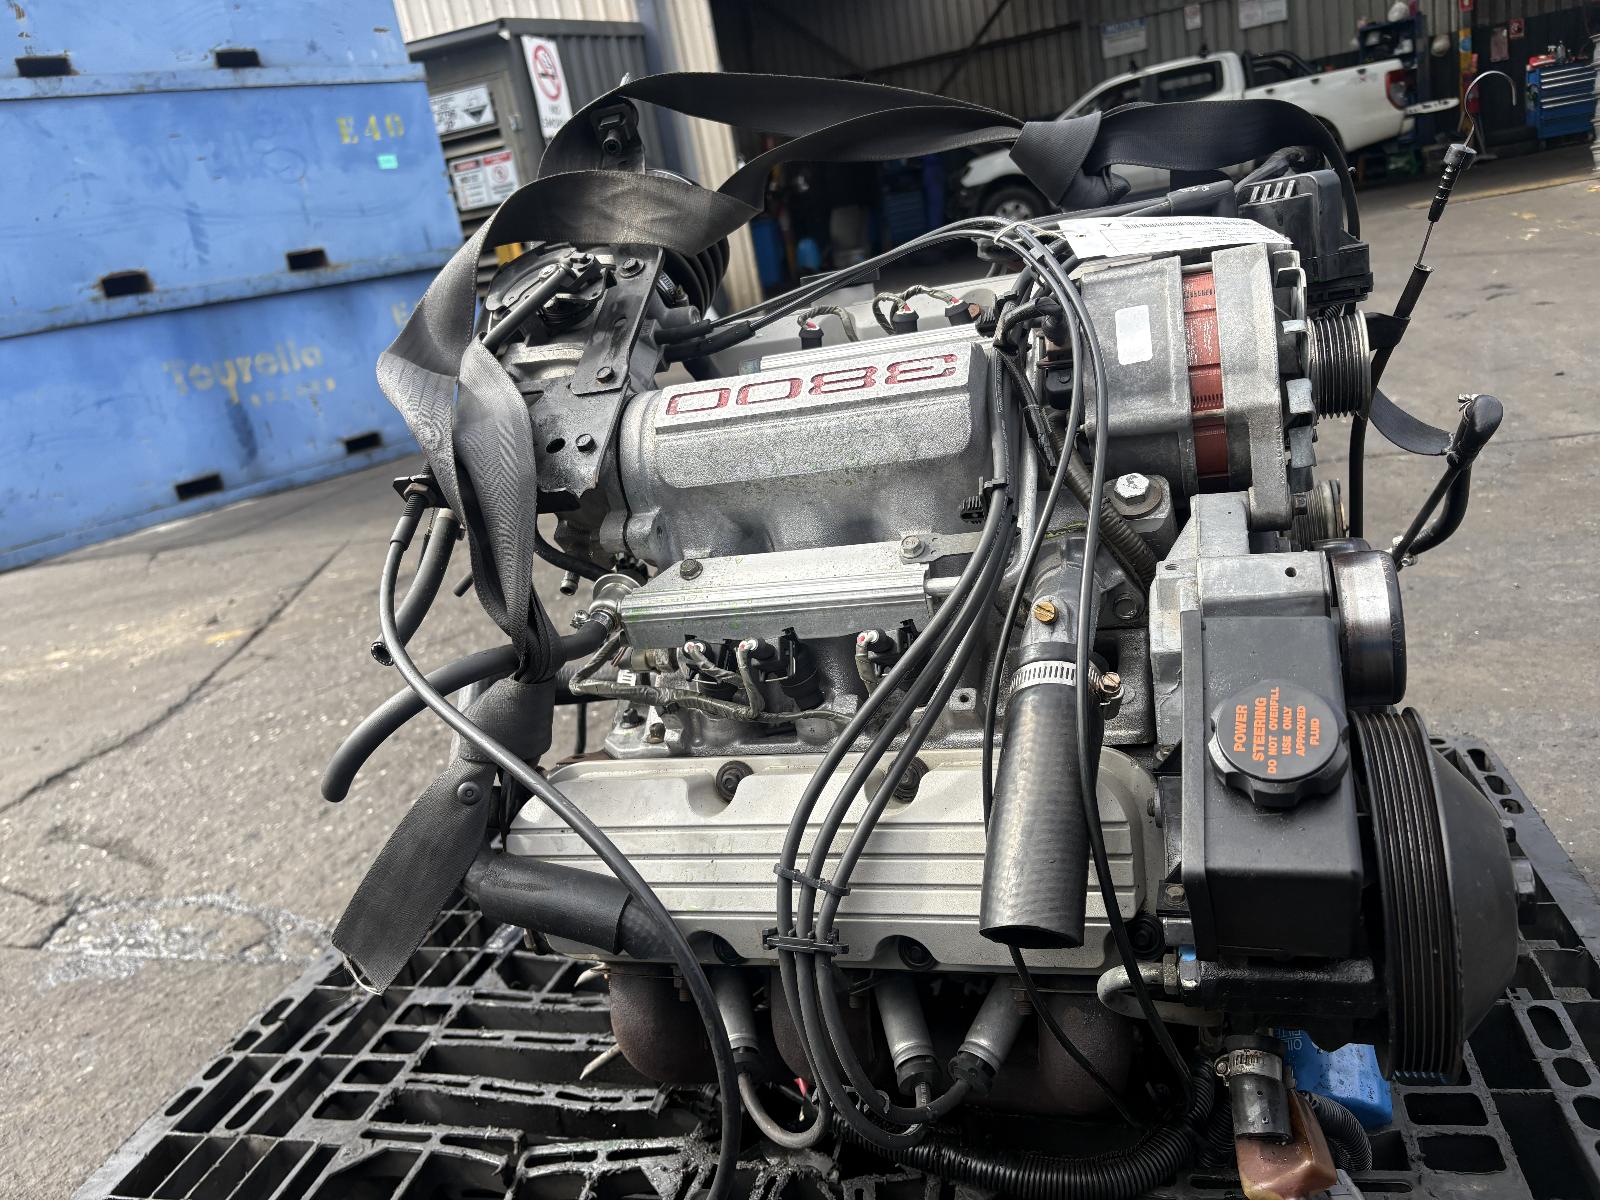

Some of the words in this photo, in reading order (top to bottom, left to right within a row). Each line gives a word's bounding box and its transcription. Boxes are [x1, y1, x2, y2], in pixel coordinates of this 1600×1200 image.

[664, 354, 959, 416] 3800
[1268, 686, 1280, 731] OVERFILL
[1282, 706, 1292, 730] ONLY
[1233, 704, 1248, 752] POWER
[1252, 697, 1267, 762] STEERING
[1268, 735, 1278, 756] NOT
[1282, 735, 1292, 755] USE
[1295, 704, 1306, 757] APPROVED
[1309, 717, 1320, 747] FLUID
[1267, 759, 1277, 775] DO
